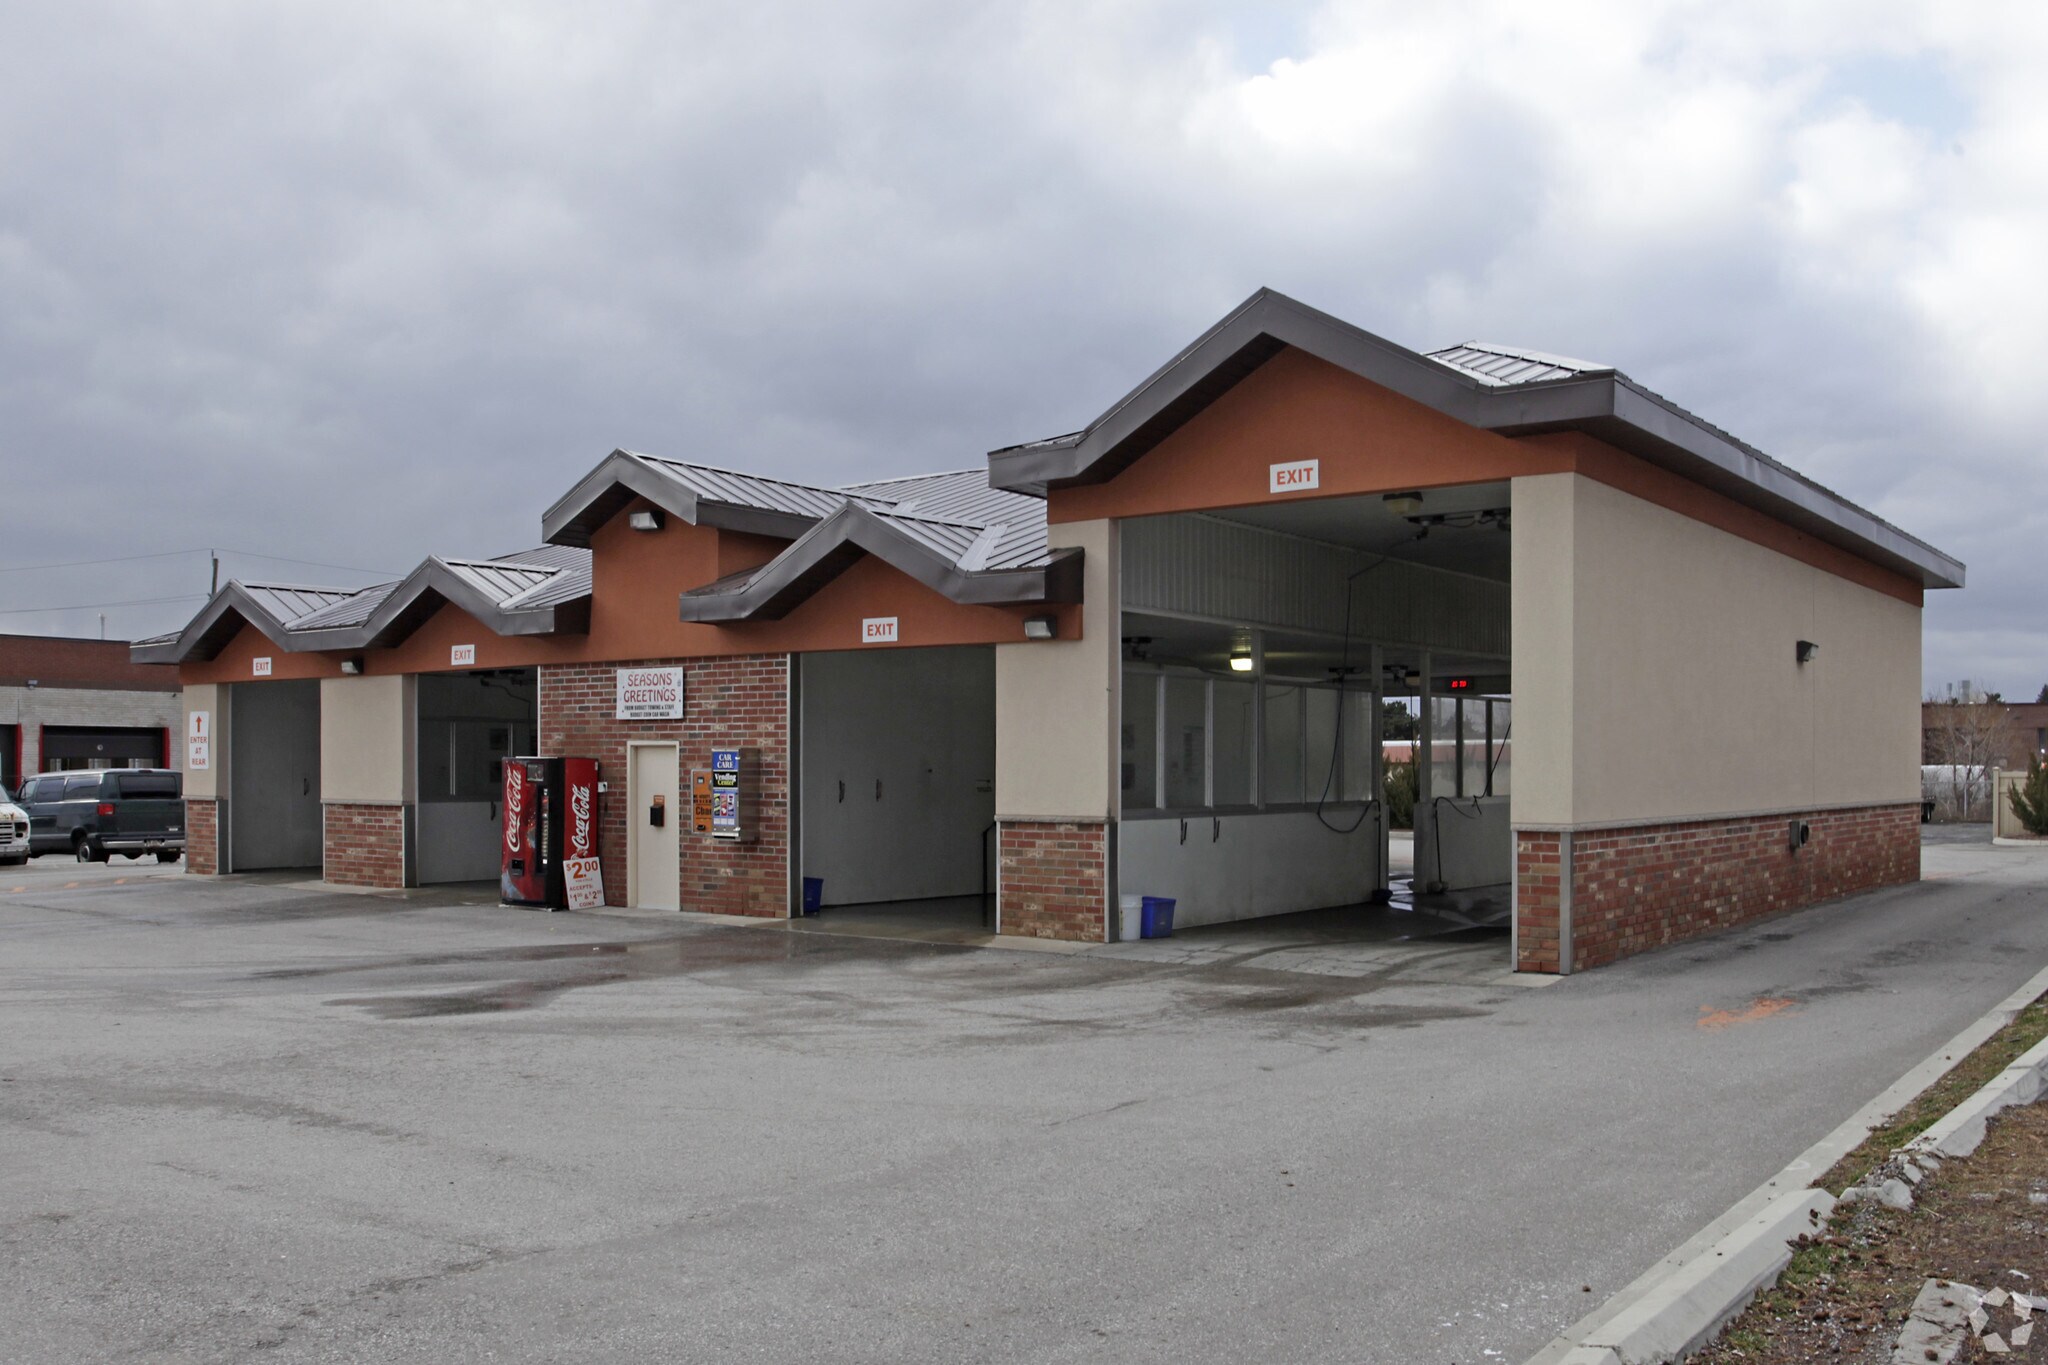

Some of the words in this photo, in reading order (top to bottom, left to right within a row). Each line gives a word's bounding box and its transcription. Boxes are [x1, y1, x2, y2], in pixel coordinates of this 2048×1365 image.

[1277, 468, 1313, 485] EXIT
[867, 623, 894, 637] EXIT
[454, 649, 472, 661] EXIT
[255, 662, 269, 671] EXIT
[627, 673, 672, 686] SEASONS
[623, 689, 676, 702] GREETINGS
[714, 773, 737, 782] Vending
